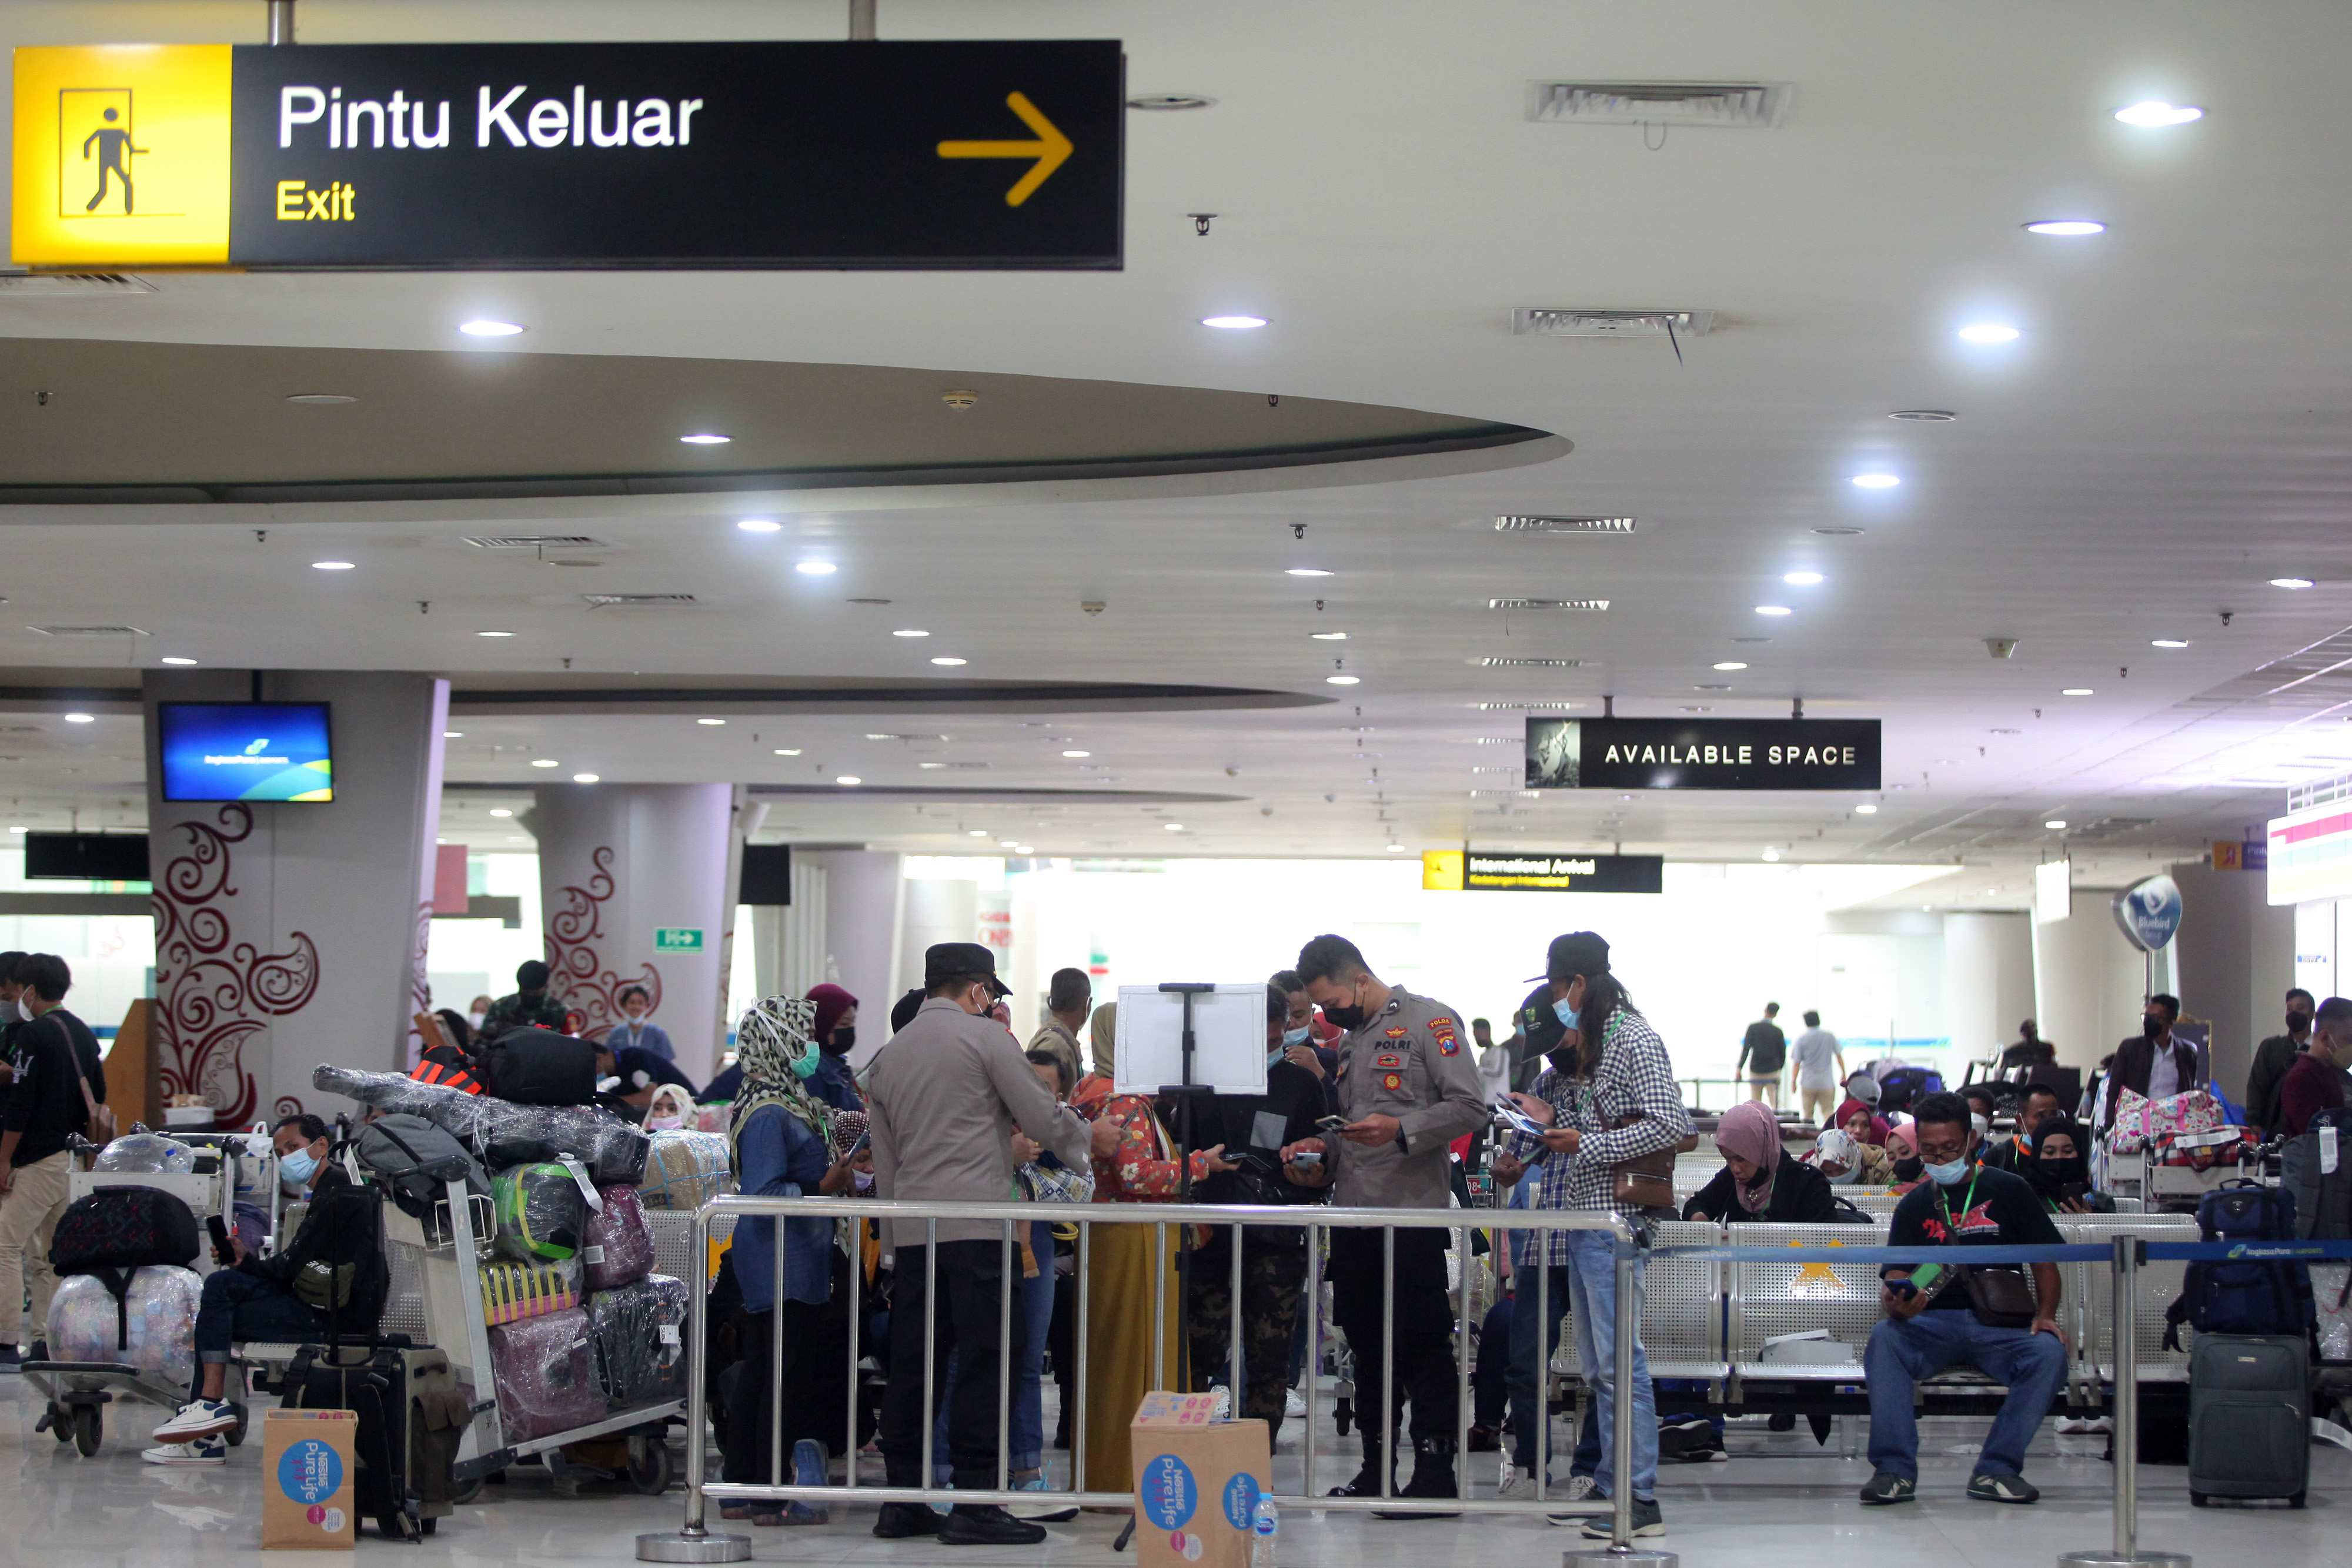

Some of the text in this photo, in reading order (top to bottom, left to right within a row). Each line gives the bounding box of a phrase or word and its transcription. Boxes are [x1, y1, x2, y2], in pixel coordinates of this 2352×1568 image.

[279, 85, 703, 148] Pintu Keluar
[277, 180, 355, 220] Exit
[1605, 745, 1855, 764] AVAILABLE SPACE
[2247, 846, 2267, 856] Pint
[1470, 857, 1595, 875] International Arrival
[2139, 916, 2170, 930] Bluebird
[1430, 1018, 1450, 1027] POLDA
[1374, 1040, 1411, 1050] POLRI
[300, 1442, 318, 1500] Pure Life
[1161, 1457, 1177, 1526] Pure Life
